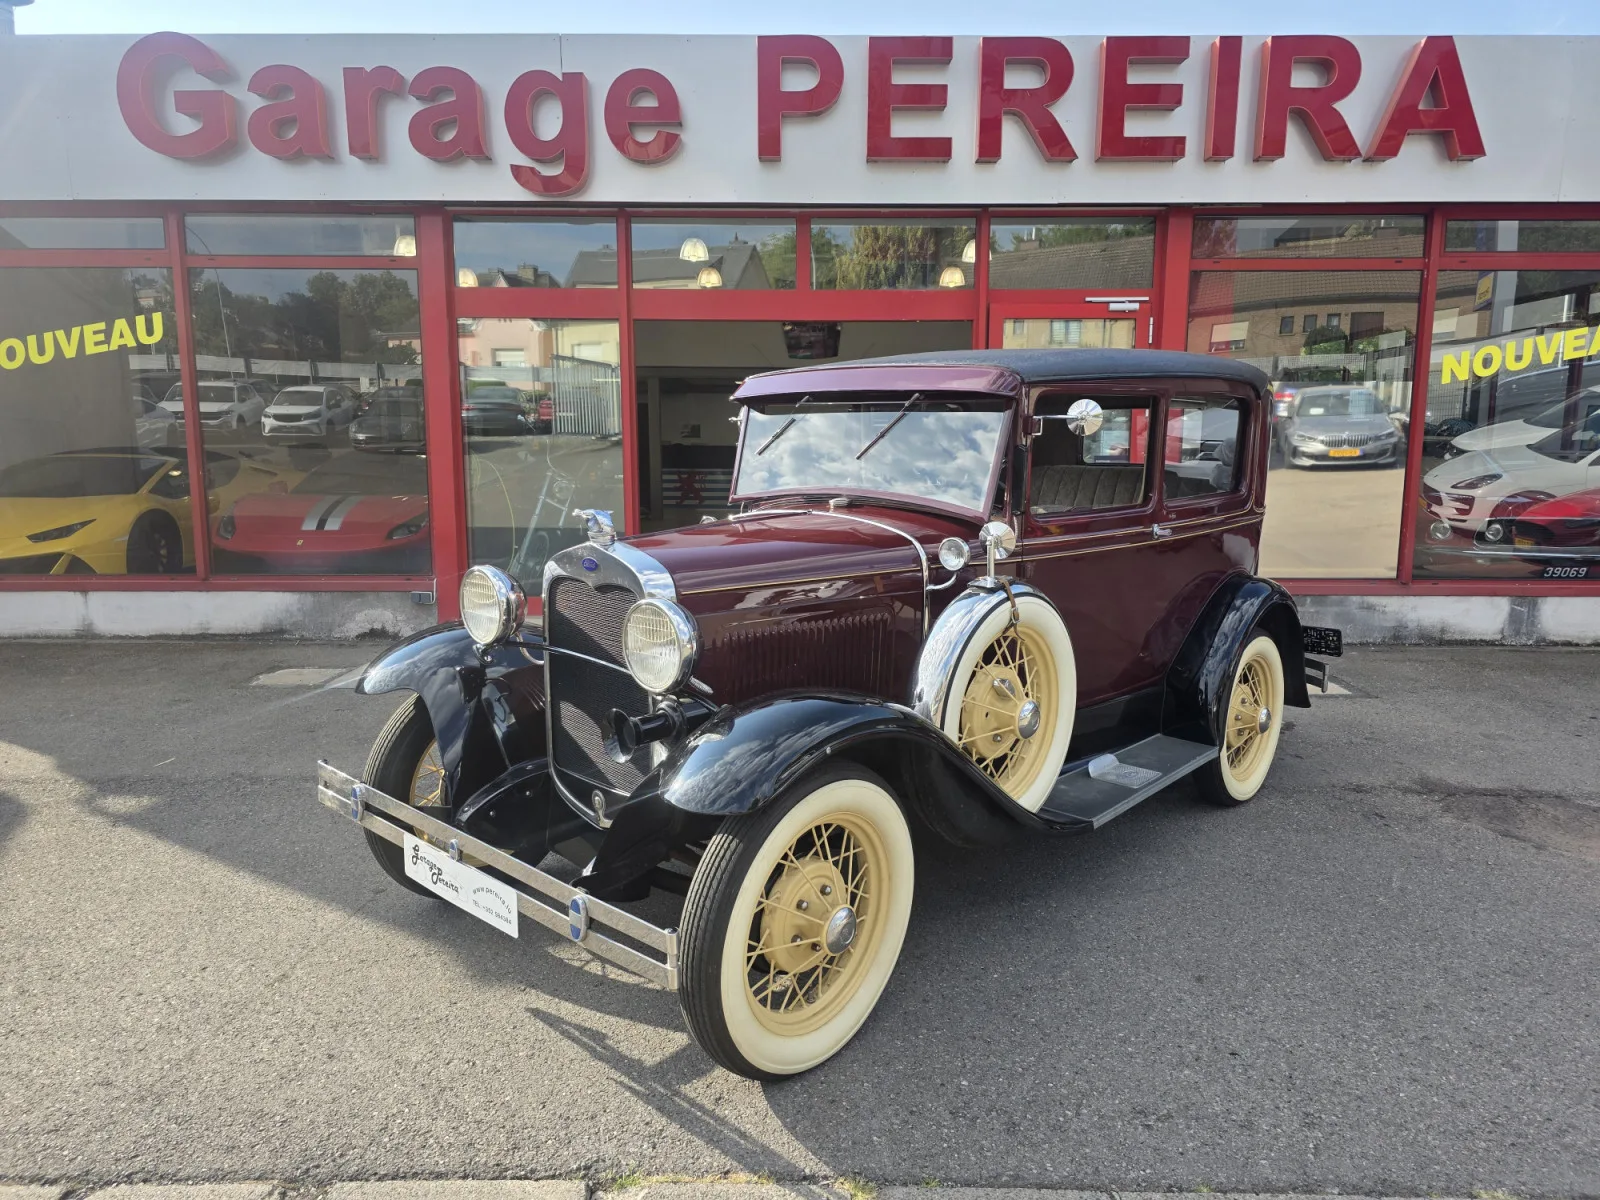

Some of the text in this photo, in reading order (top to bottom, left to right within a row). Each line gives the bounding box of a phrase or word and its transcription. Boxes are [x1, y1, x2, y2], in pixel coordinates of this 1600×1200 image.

[116, 31, 1487, 197] Garage PEREIRA
[0, 312, 164, 370] OUVEAU
[1543, 567, 1587, 577] 39069
[412, 844, 438, 872] Garage
[431, 866, 459, 894] Pereira
